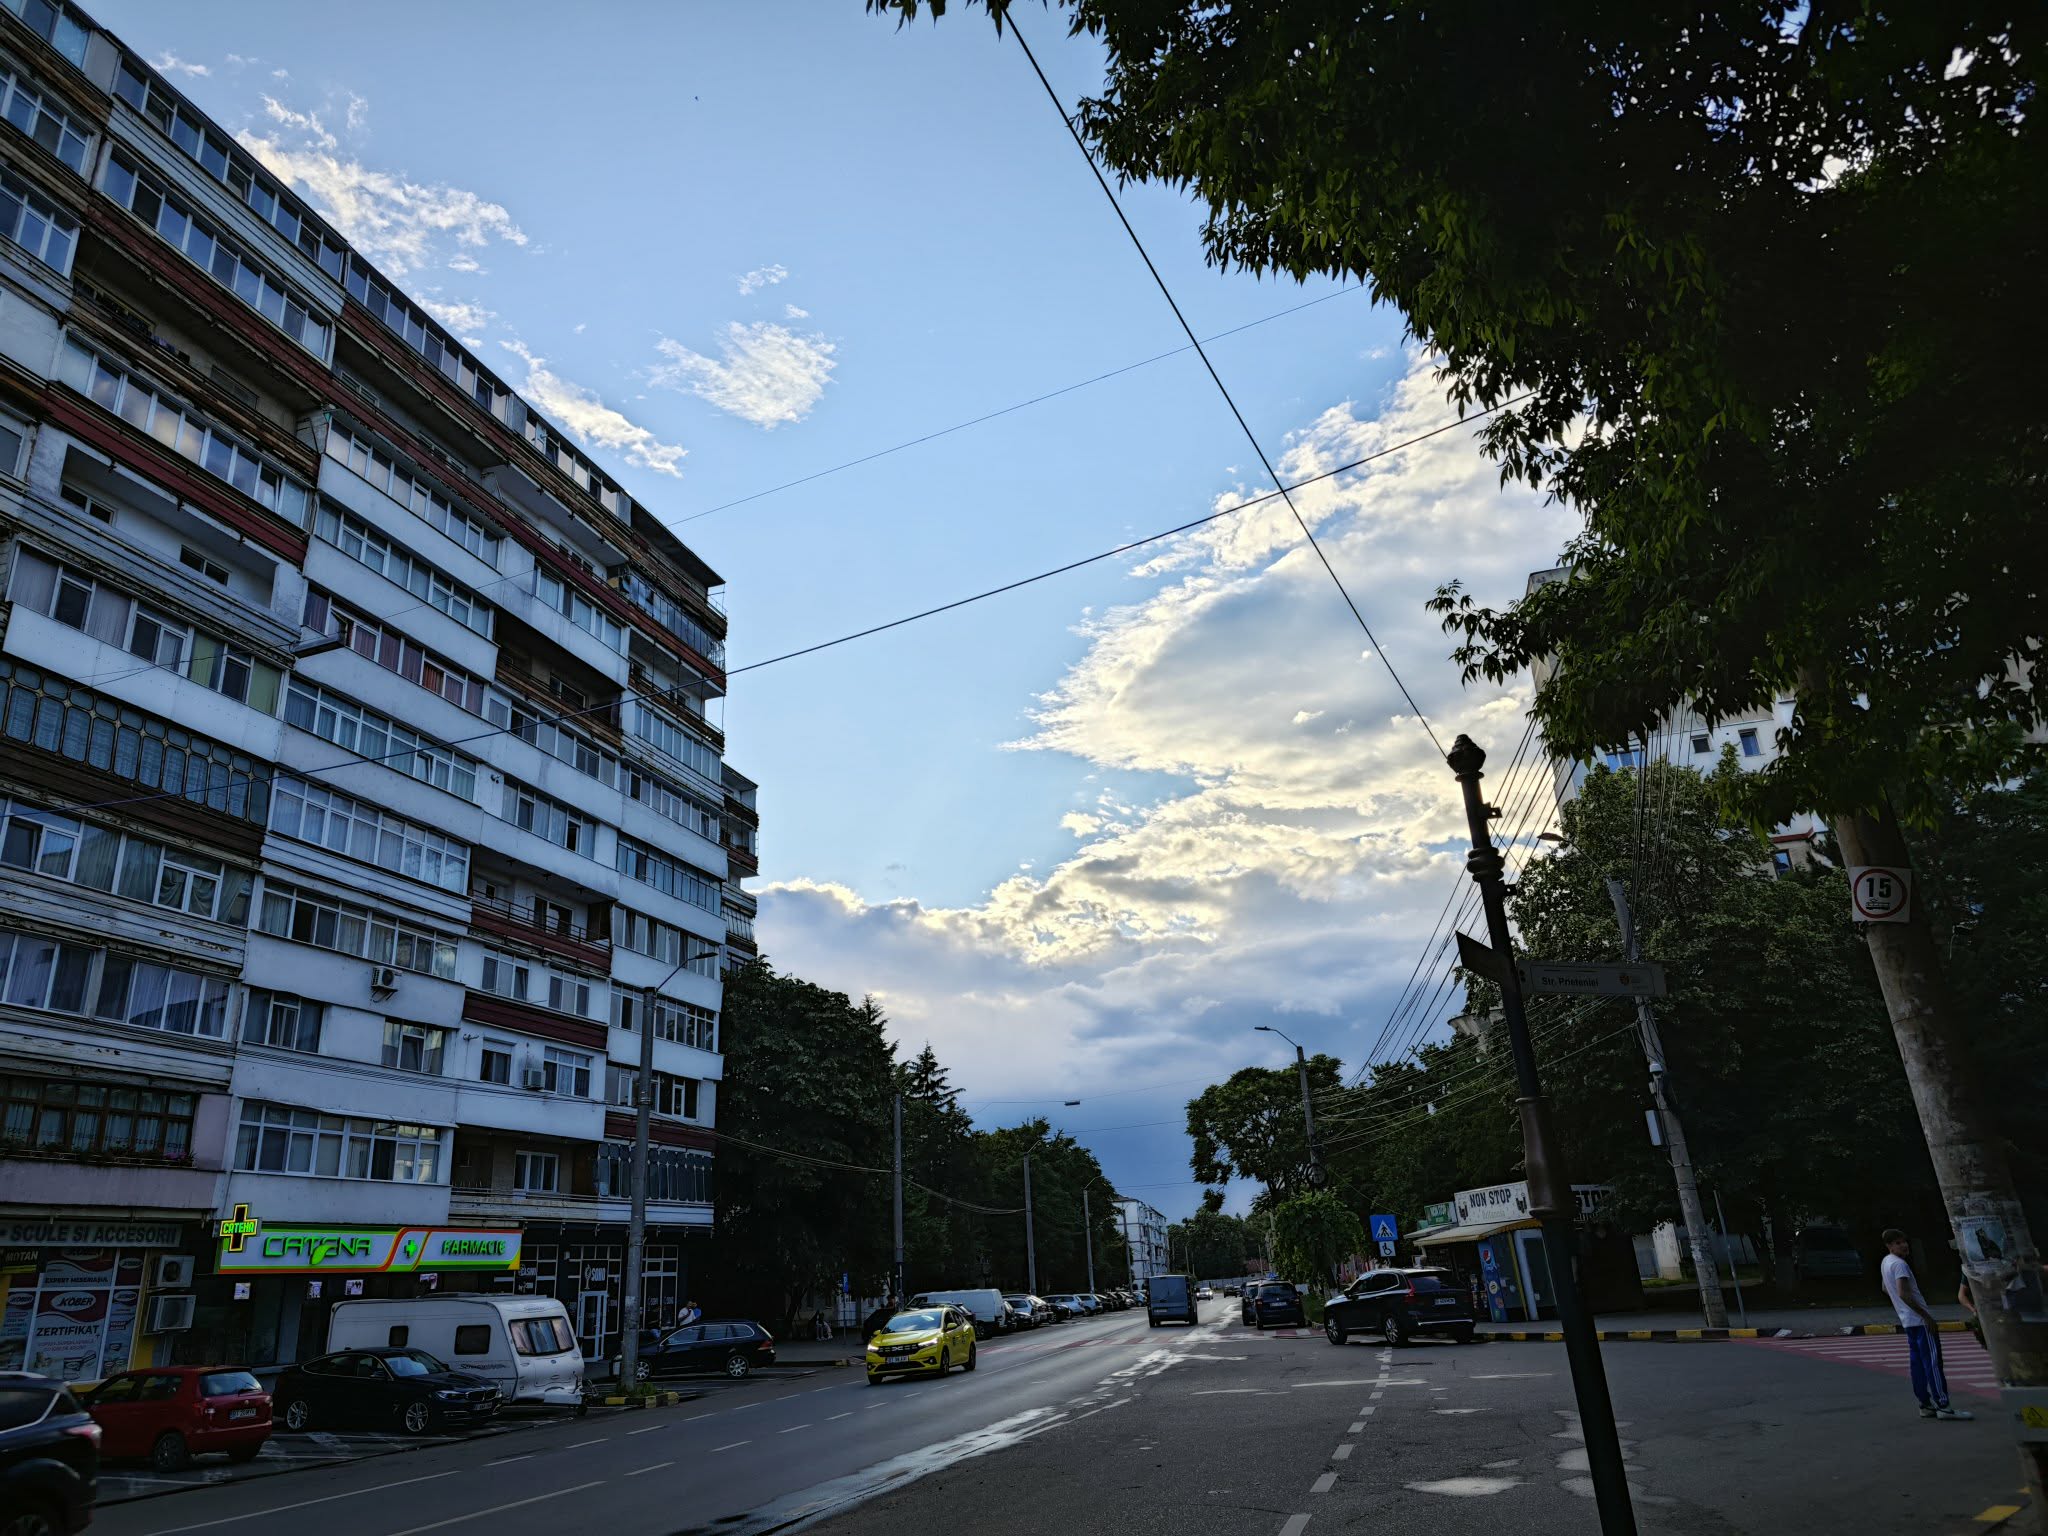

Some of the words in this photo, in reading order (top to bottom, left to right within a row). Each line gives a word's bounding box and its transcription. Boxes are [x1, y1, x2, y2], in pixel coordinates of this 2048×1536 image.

[1866, 878, 1891, 898] 15
[1469, 1193, 1487, 1208] NON
[1488, 1188, 1511, 1205] STOP
[10, 1224, 69, 1242] SCULE
[94, 1225, 177, 1244] ACCESORII
[223, 1221, 256, 1233] CATENA
[263, 1236, 372, 1262] CATENA
[441, 1239, 506, 1256] FARMACIE
[36, 1325, 100, 1337] ZERTIFIKAT
